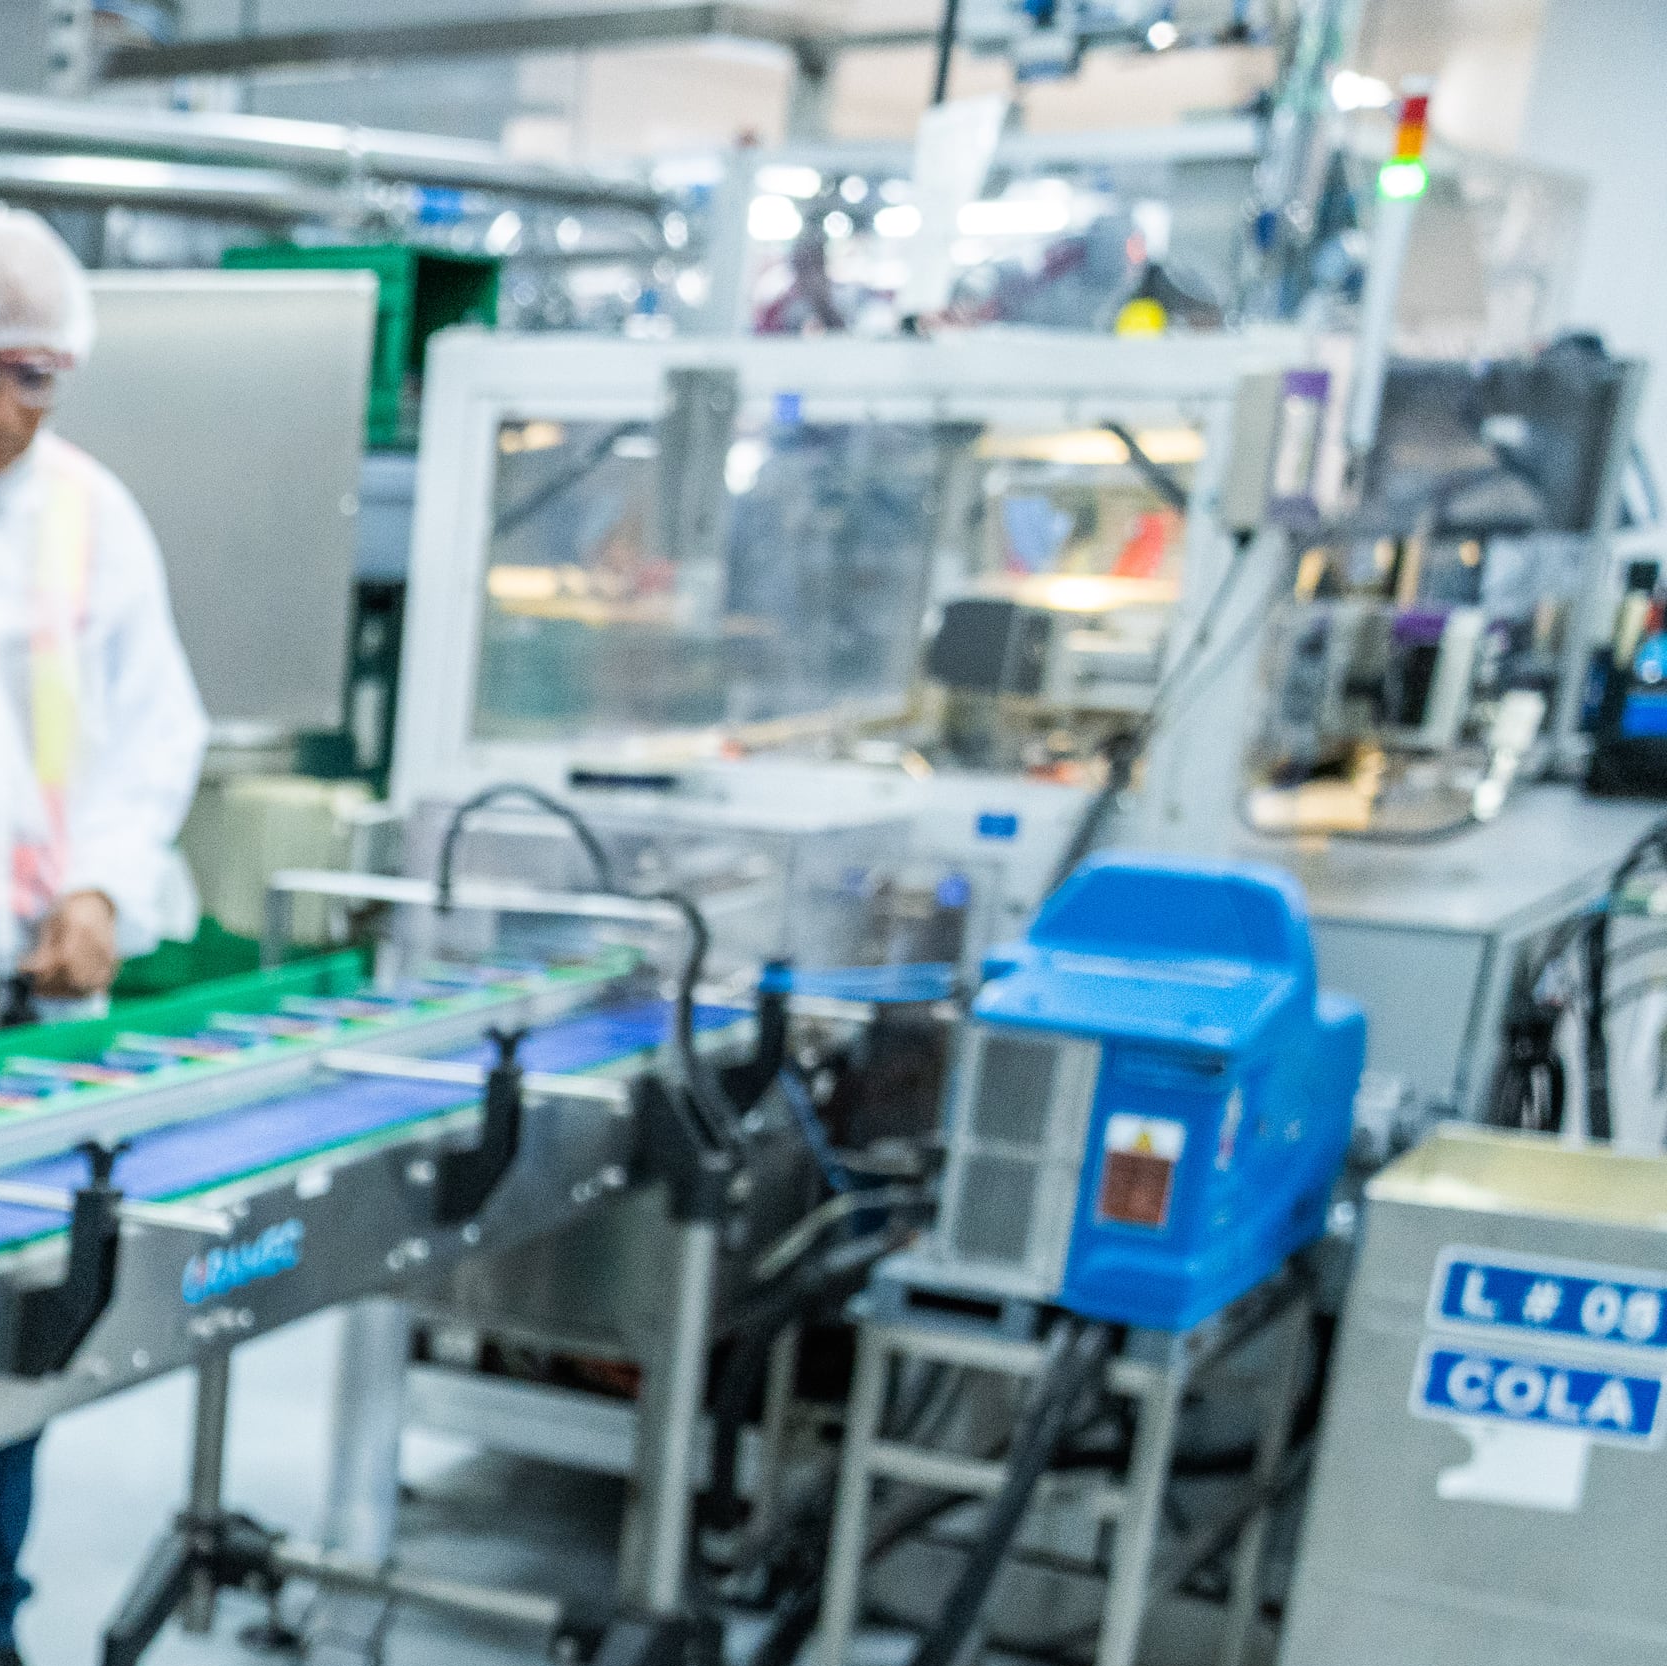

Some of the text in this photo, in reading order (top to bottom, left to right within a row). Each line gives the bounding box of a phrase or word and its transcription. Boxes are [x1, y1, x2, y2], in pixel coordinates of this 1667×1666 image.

[1461, 1269, 1498, 1320] L
[1522, 1280, 1563, 1322] #
[1446, 1359, 1634, 1429] COLA
